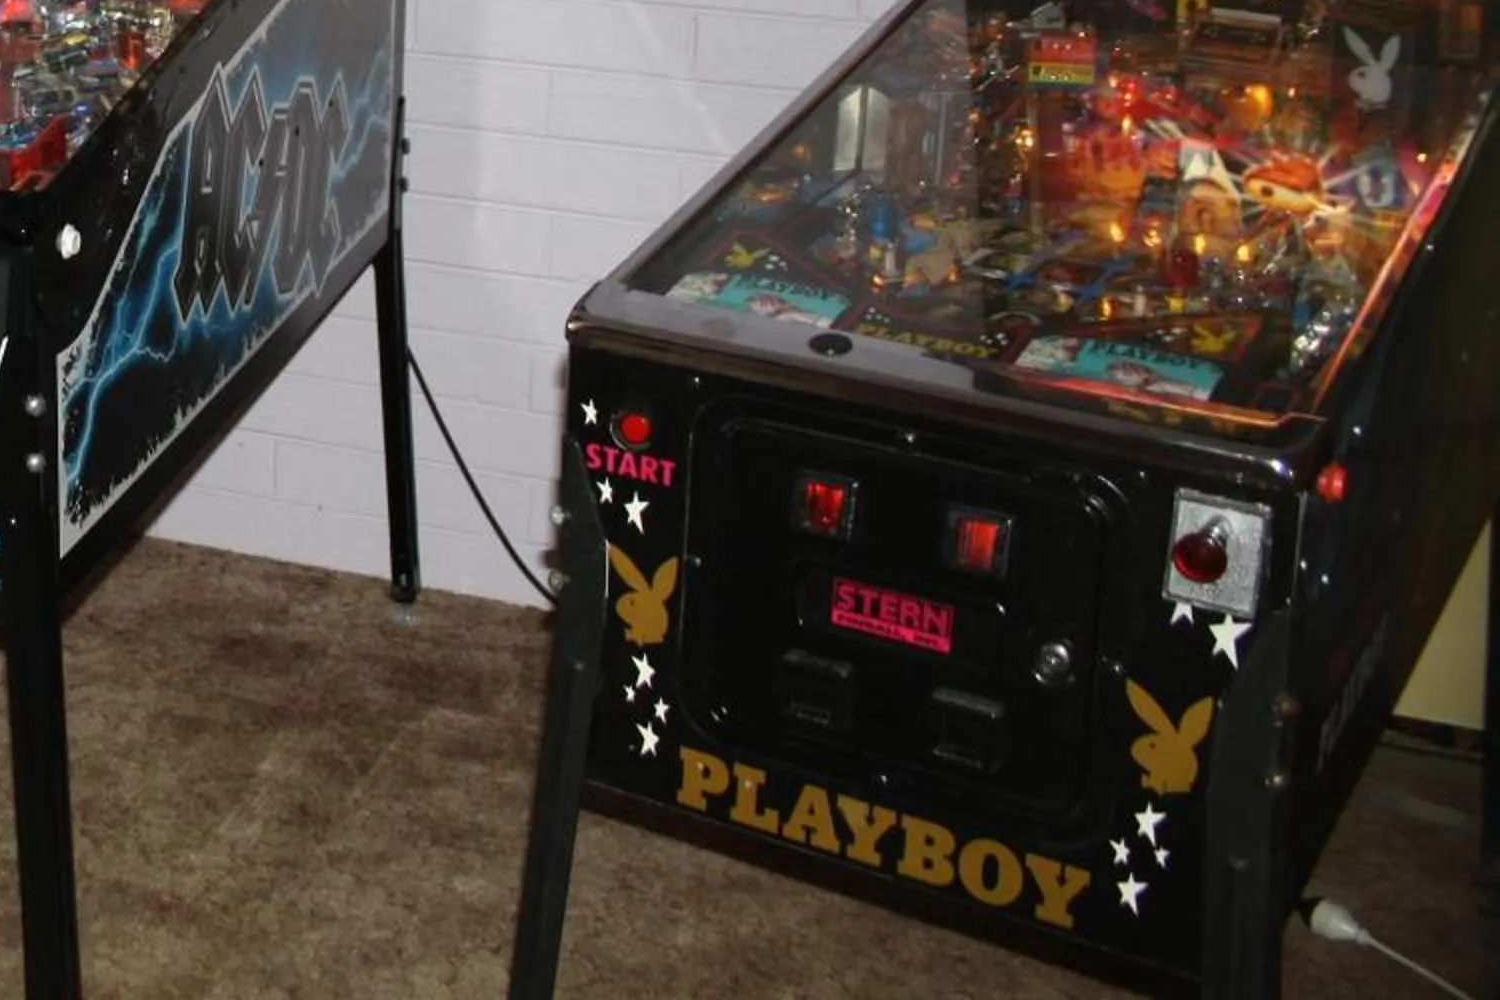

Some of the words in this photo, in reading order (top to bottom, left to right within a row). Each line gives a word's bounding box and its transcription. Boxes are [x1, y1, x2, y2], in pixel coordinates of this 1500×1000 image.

[586, 443, 676, 487] START
[838, 583, 949, 636] STERN
[676, 745, 1091, 929] PLAYBOY
